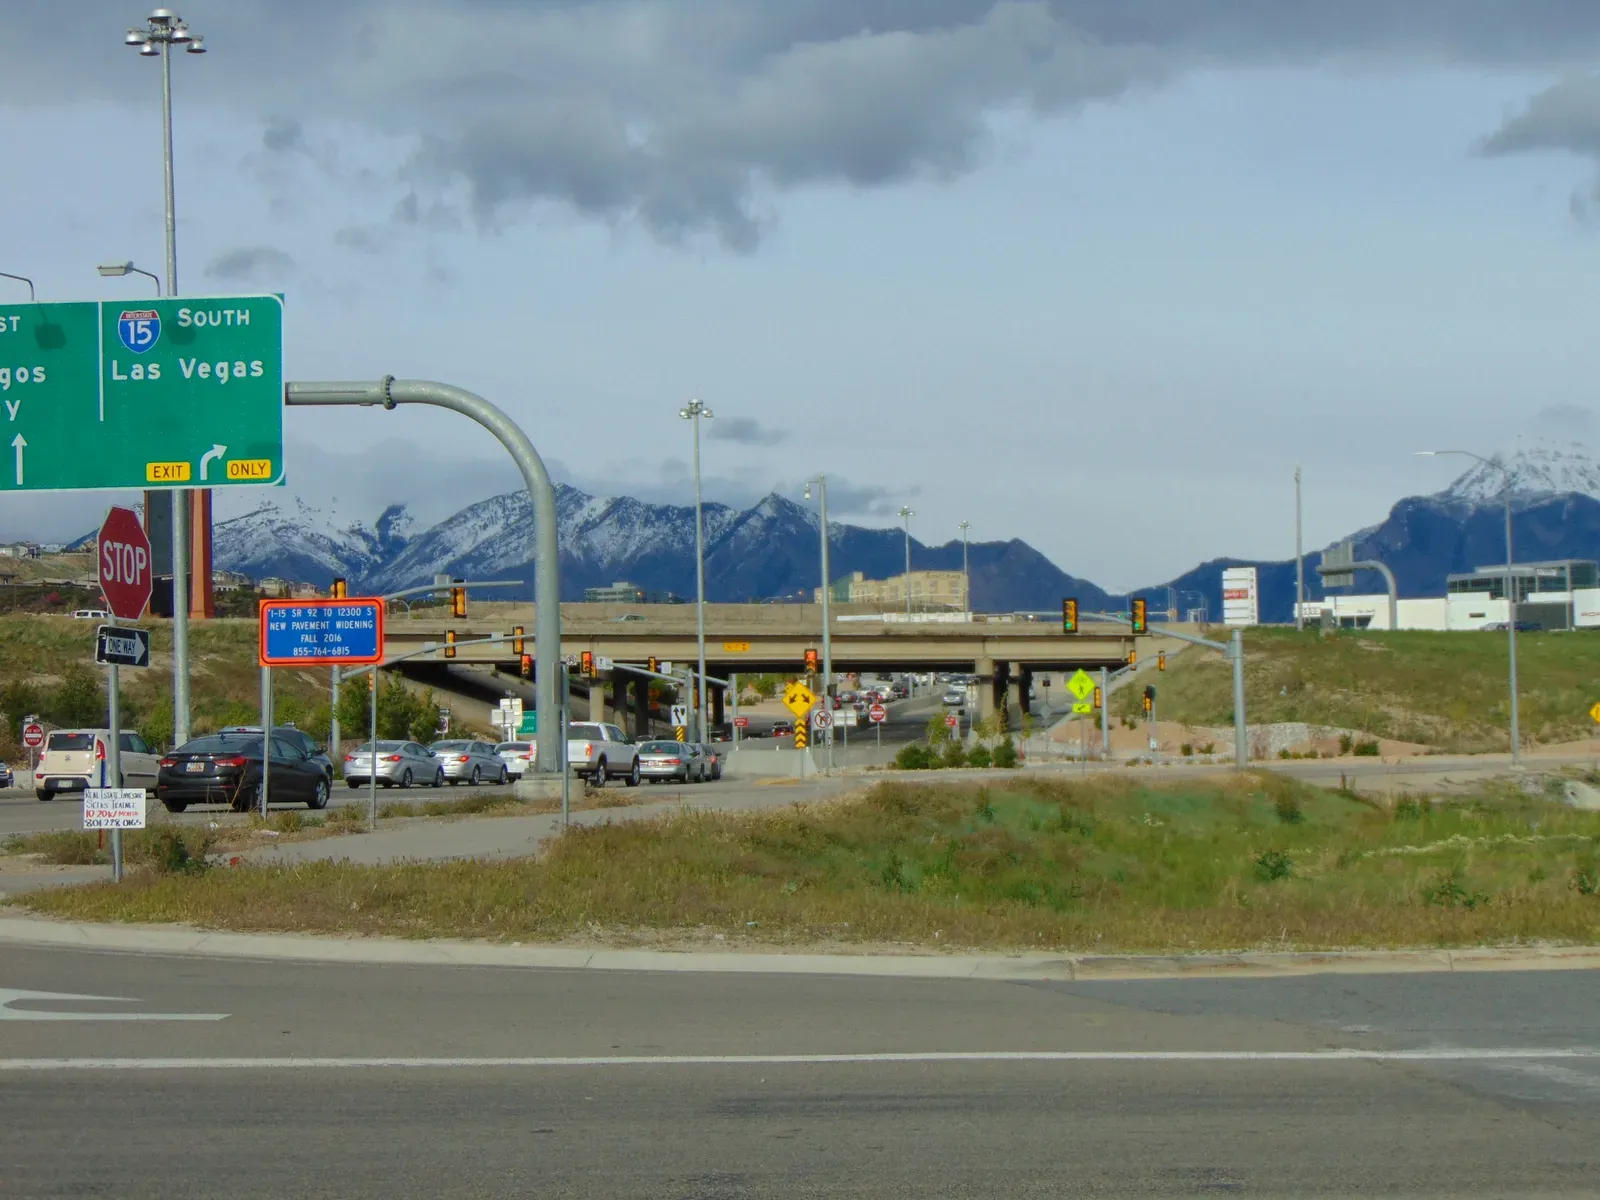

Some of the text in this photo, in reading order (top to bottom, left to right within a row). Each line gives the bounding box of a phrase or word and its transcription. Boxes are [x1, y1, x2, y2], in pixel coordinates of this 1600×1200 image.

[178, 308, 250, 327] SOUTH
[128, 321, 152, 345] 15
[112, 358, 264, 385] Las Vegas
[153, 462, 267, 478] EXIT ONLY
[103, 539, 147, 586] STOP
[292, 609, 302, 618] SR
[307, 608, 317, 618] 92
[323, 608, 333, 617] TO
[338, 607, 361, 617] 12300
[367, 607, 372, 616] S
[269, 620, 373, 631] NEW PAVEMENT WIDENING
[300, 633, 342, 643] FALL 2016
[109, 638, 136, 655] ONE WAY
[292, 646, 350, 656] 855-764-6815
[85, 819, 102, 827] 801
